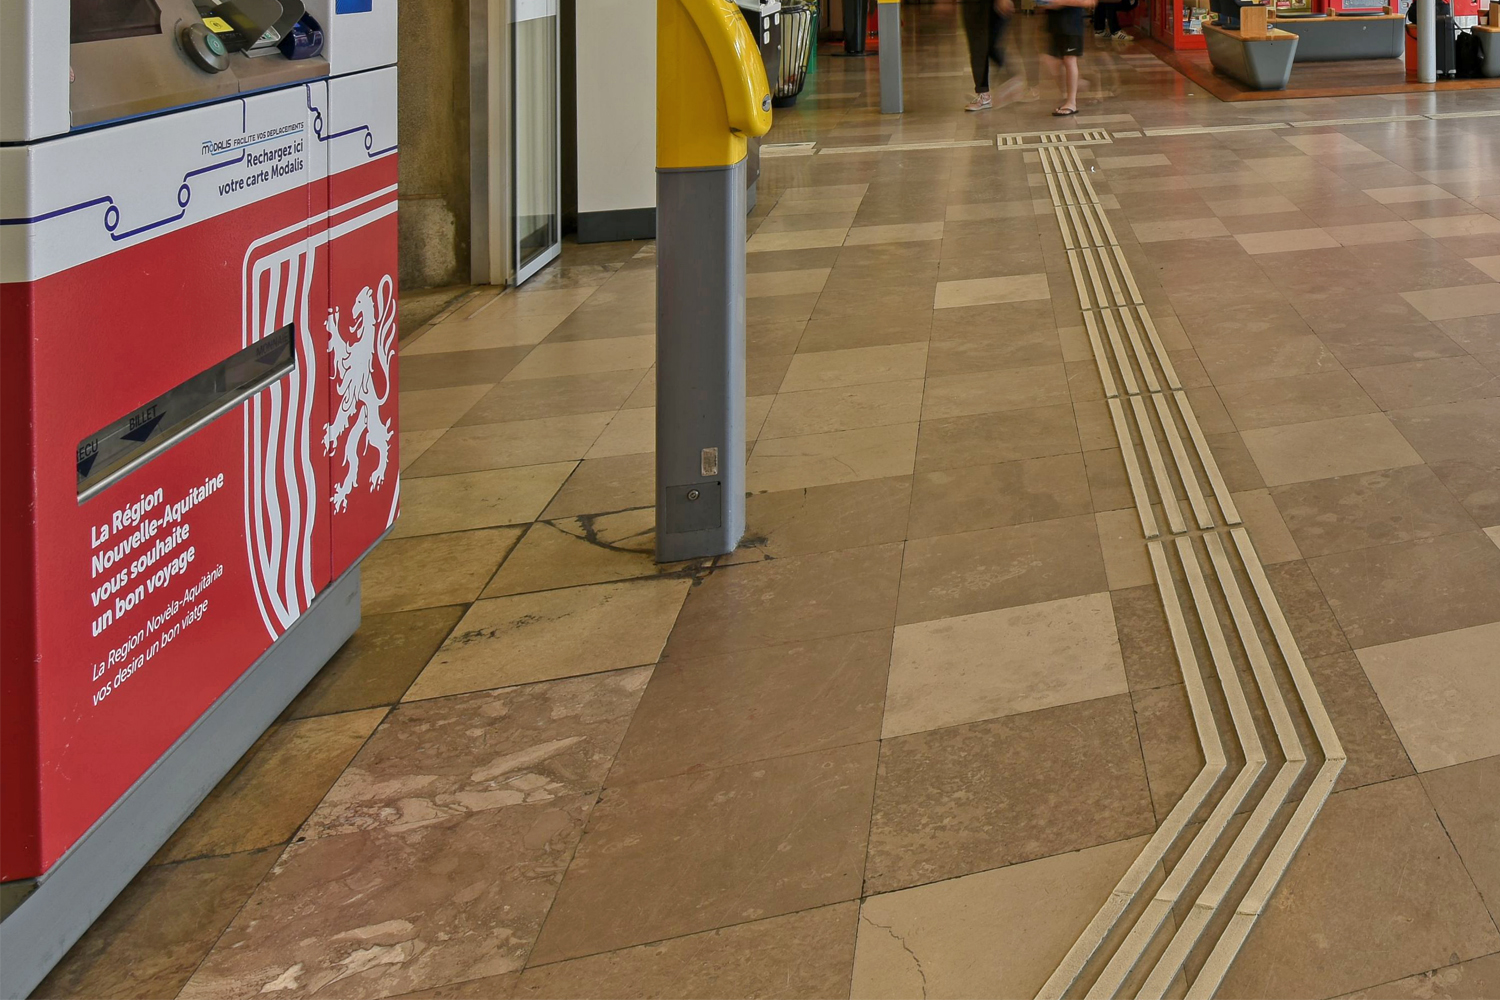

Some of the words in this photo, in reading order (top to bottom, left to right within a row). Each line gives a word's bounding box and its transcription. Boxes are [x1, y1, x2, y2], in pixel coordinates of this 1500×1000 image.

[233, 134, 256, 147] FACILITE
[256, 131, 267, 140] VOS
[246, 144, 292, 168] Rechargez
[294, 138, 303, 153] ici
[218, 176, 244, 196] votre
[246, 170, 269, 187] carte
[271, 157, 304, 180] Modalis
[129, 404, 158, 431] BILLET
[91, 524, 109, 549] La
[112, 486, 164, 534] Région
[91, 472, 224, 578] Nouvelle-Aquitaine
[90, 573, 128, 607] vous
[130, 523, 190, 580] souhaite
[92, 612, 113, 637] un
[115, 586, 145, 621] bon
[146, 545, 196, 596] voyage
[93, 661, 106, 682] La
[107, 629, 144, 666] Region
[146, 562, 223, 637] Novèla-Aquitània
[93, 682, 112, 706] vos
[113, 651, 144, 687] desira
[146, 639, 160, 662] un
[161, 620, 180, 648] bon
[181, 597, 209, 633] viatge
